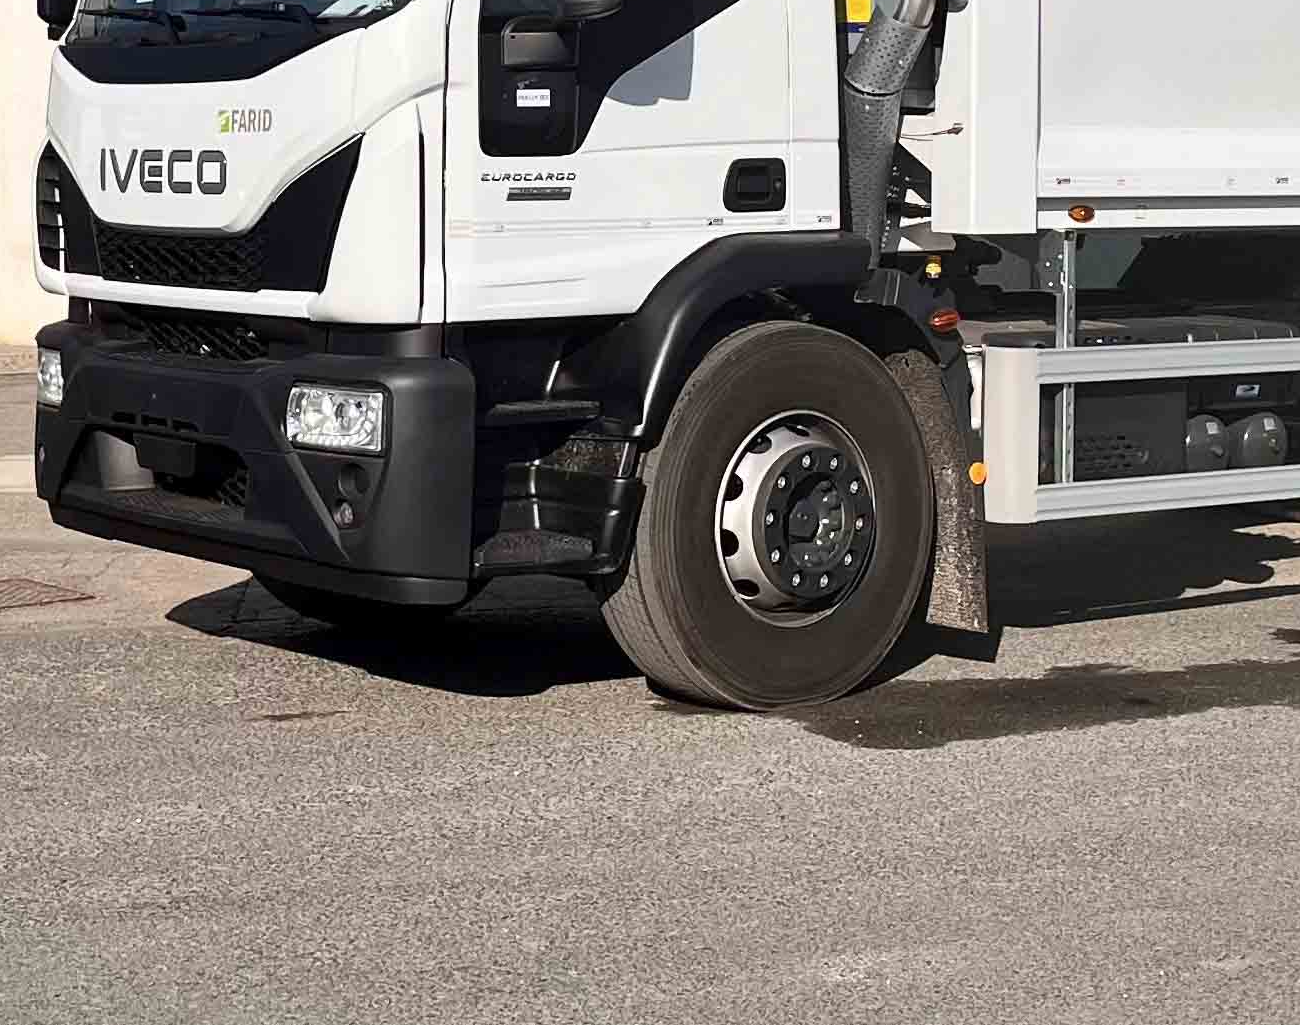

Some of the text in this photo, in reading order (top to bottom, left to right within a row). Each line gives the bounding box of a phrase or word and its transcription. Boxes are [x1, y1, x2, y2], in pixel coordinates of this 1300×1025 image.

[231, 109, 272, 133] FARID
[100, 148, 227, 195] IVECO
[480, 172, 577, 182] EUROCARGO
